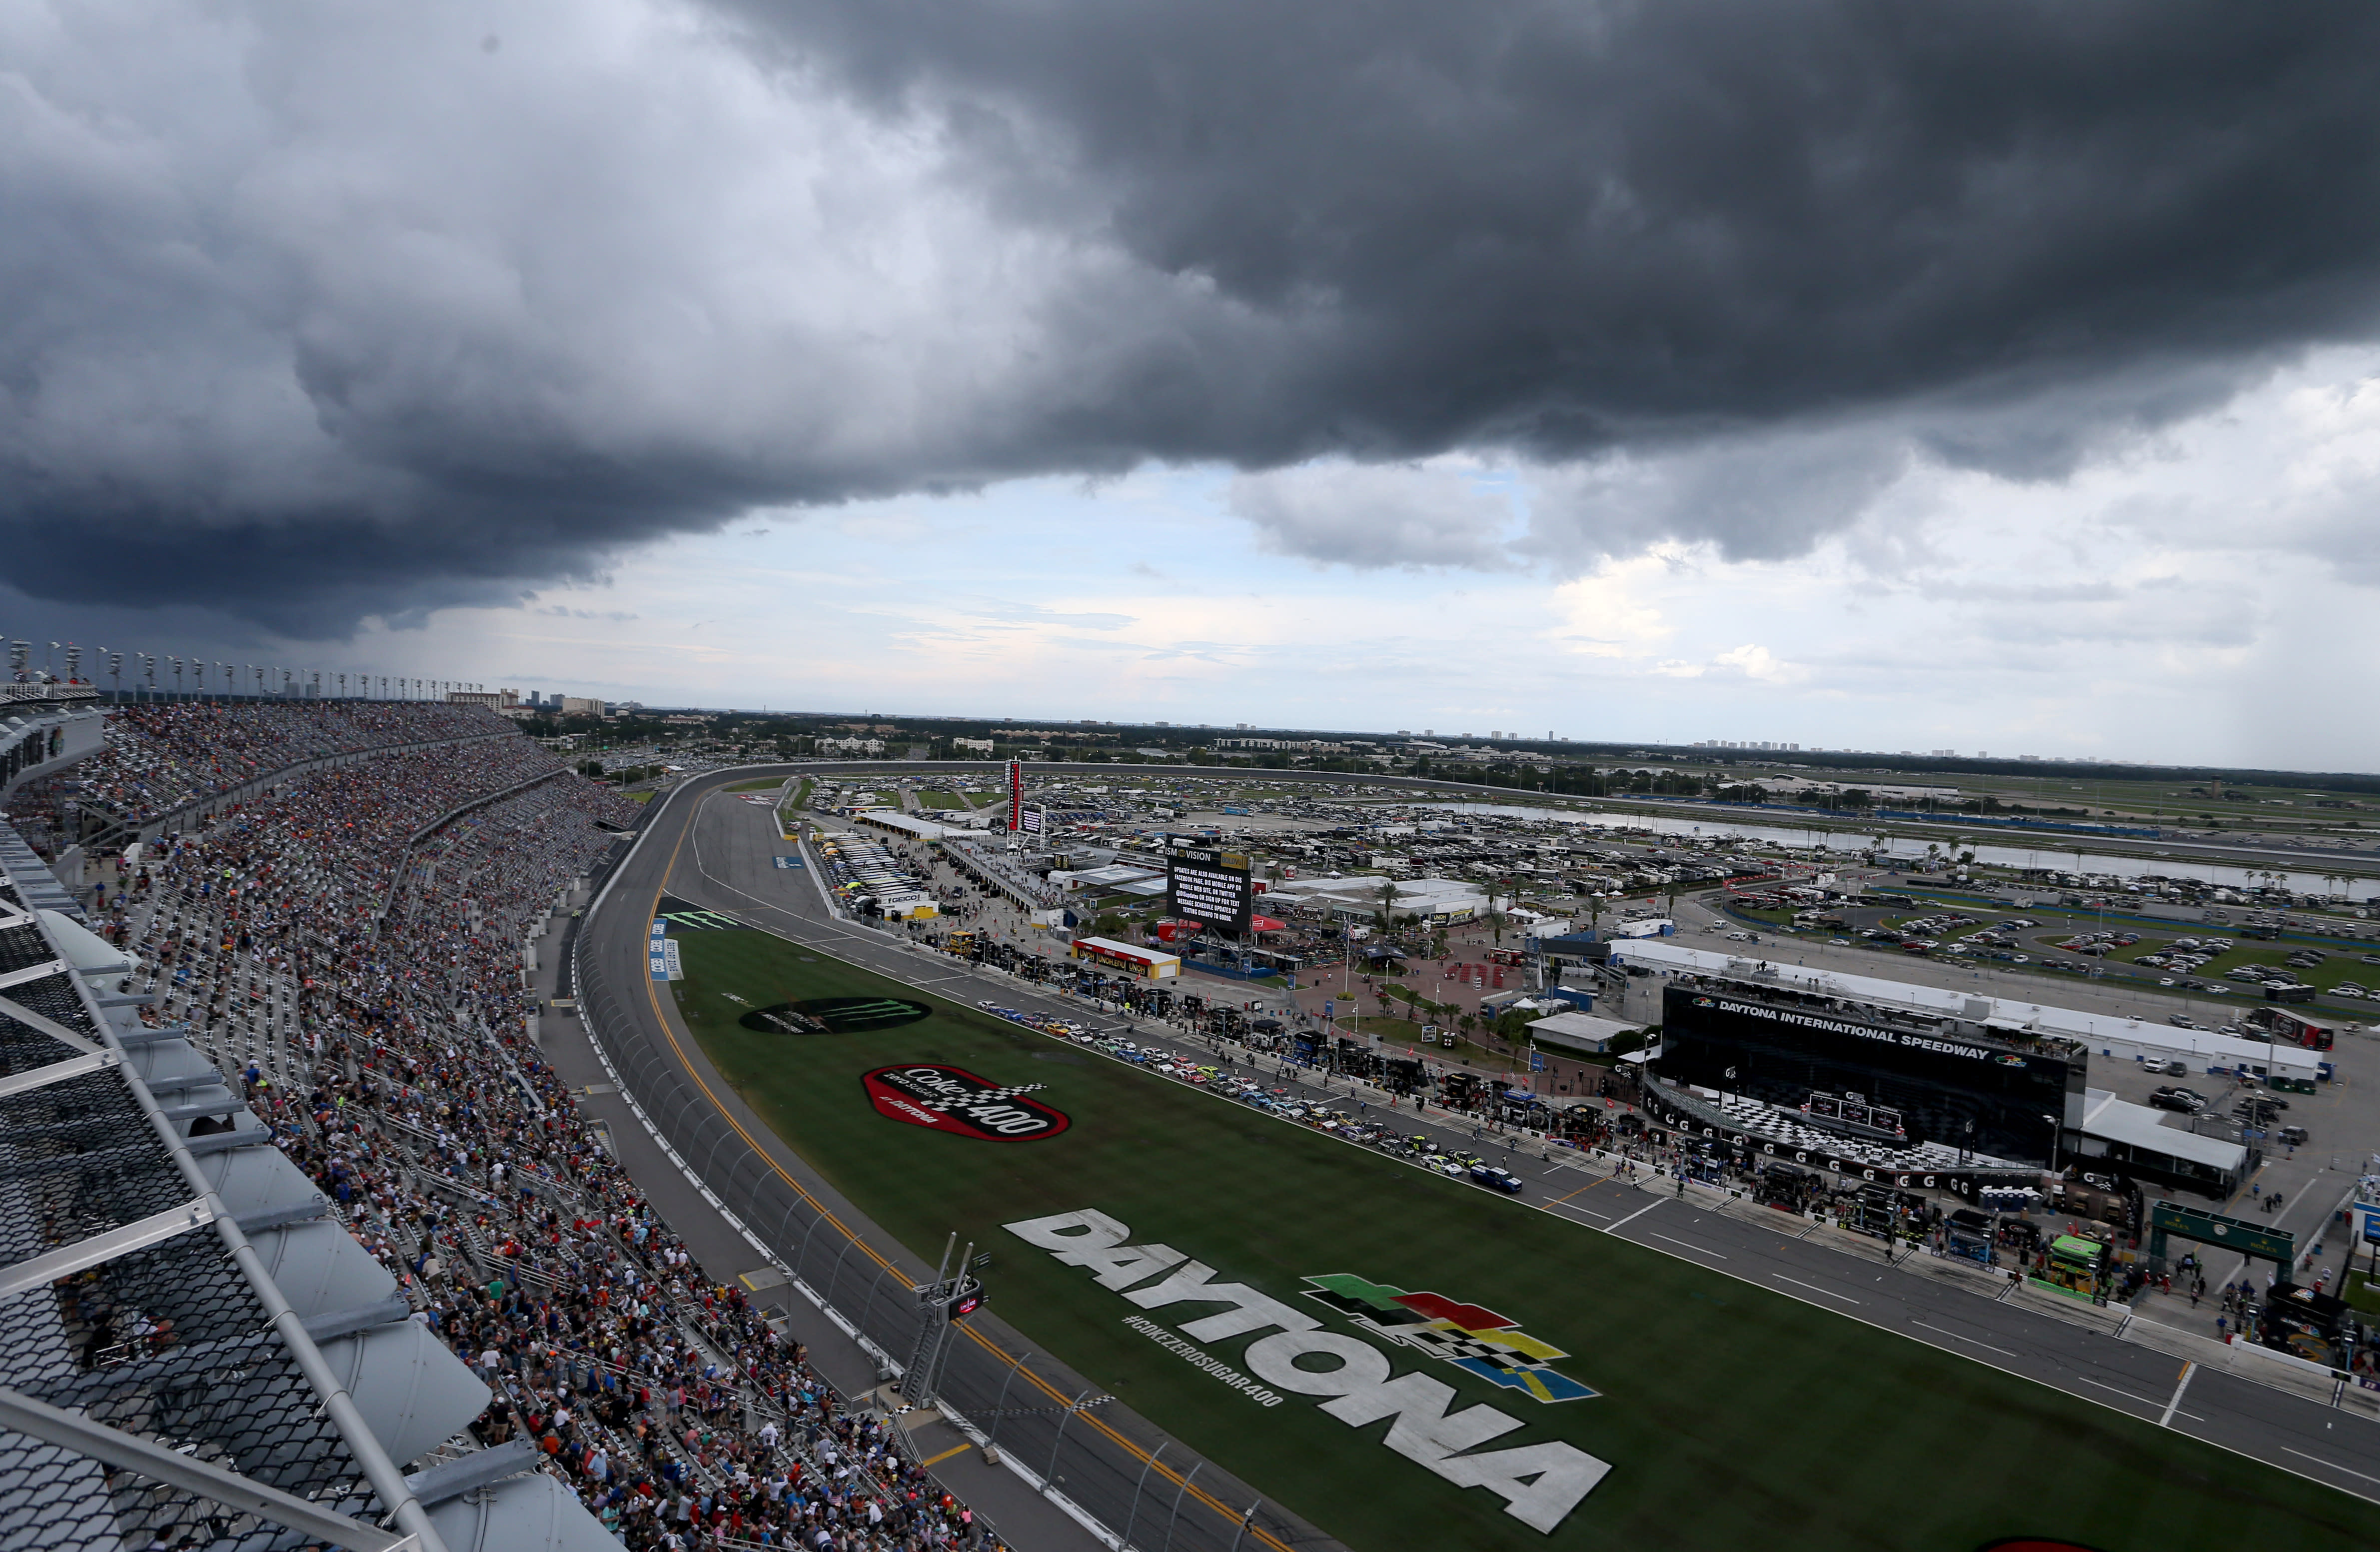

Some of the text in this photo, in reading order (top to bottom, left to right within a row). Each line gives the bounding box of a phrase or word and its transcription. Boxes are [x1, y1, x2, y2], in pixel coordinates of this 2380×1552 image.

[1165, 847, 1210, 861] ISM VISION
[1175, 874, 1192, 883] FACEBOOK
[1208, 872, 1227, 881] AVAILABLE
[1219, 890, 1235, 898] TWITTER
[1194, 901, 1213, 910] SCHEDULE
[1214, 905, 1231, 914] UPDATES
[1080, 949, 1095, 960] UNOH
[1099, 955, 1125, 968] UNOH.EDU
[1129, 963, 1146, 973] UNOH
[1719, 1001, 1990, 1060] DAYTONA INTERNATIONAL SPEEDWAY
[883, 1073, 938, 1098] zero SUGAR
[904, 1069, 967, 1095] Coke
[889, 1100, 939, 1123] DAYTONA
[966, 1105, 1048, 1134] 400
[1679, 1120, 1689, 1131] G
[1703, 1128, 1713, 1137] G
[1733, 1135, 1743, 1146] G
[1764, 1143, 1774, 1154] G
[1796, 1152, 1806, 1163] G
[1829, 1160, 1840, 1171] G
[1863, 1169, 1875, 1181] G
[2083, 1172, 2095, 1183] G
[1899, 1175, 1909, 1187] G
[1923, 1175, 1934, 1187] G
[1950, 1178, 1958, 1191] G
[1961, 1182, 1969, 1195] G
[2165, 1220, 2190, 1230] ROLEX
[2251, 1242, 2278, 1253] ROLEX
[1963, 1260, 1980, 1268] HIGH
[1000, 1207, 1613, 1535] DAYTONA
